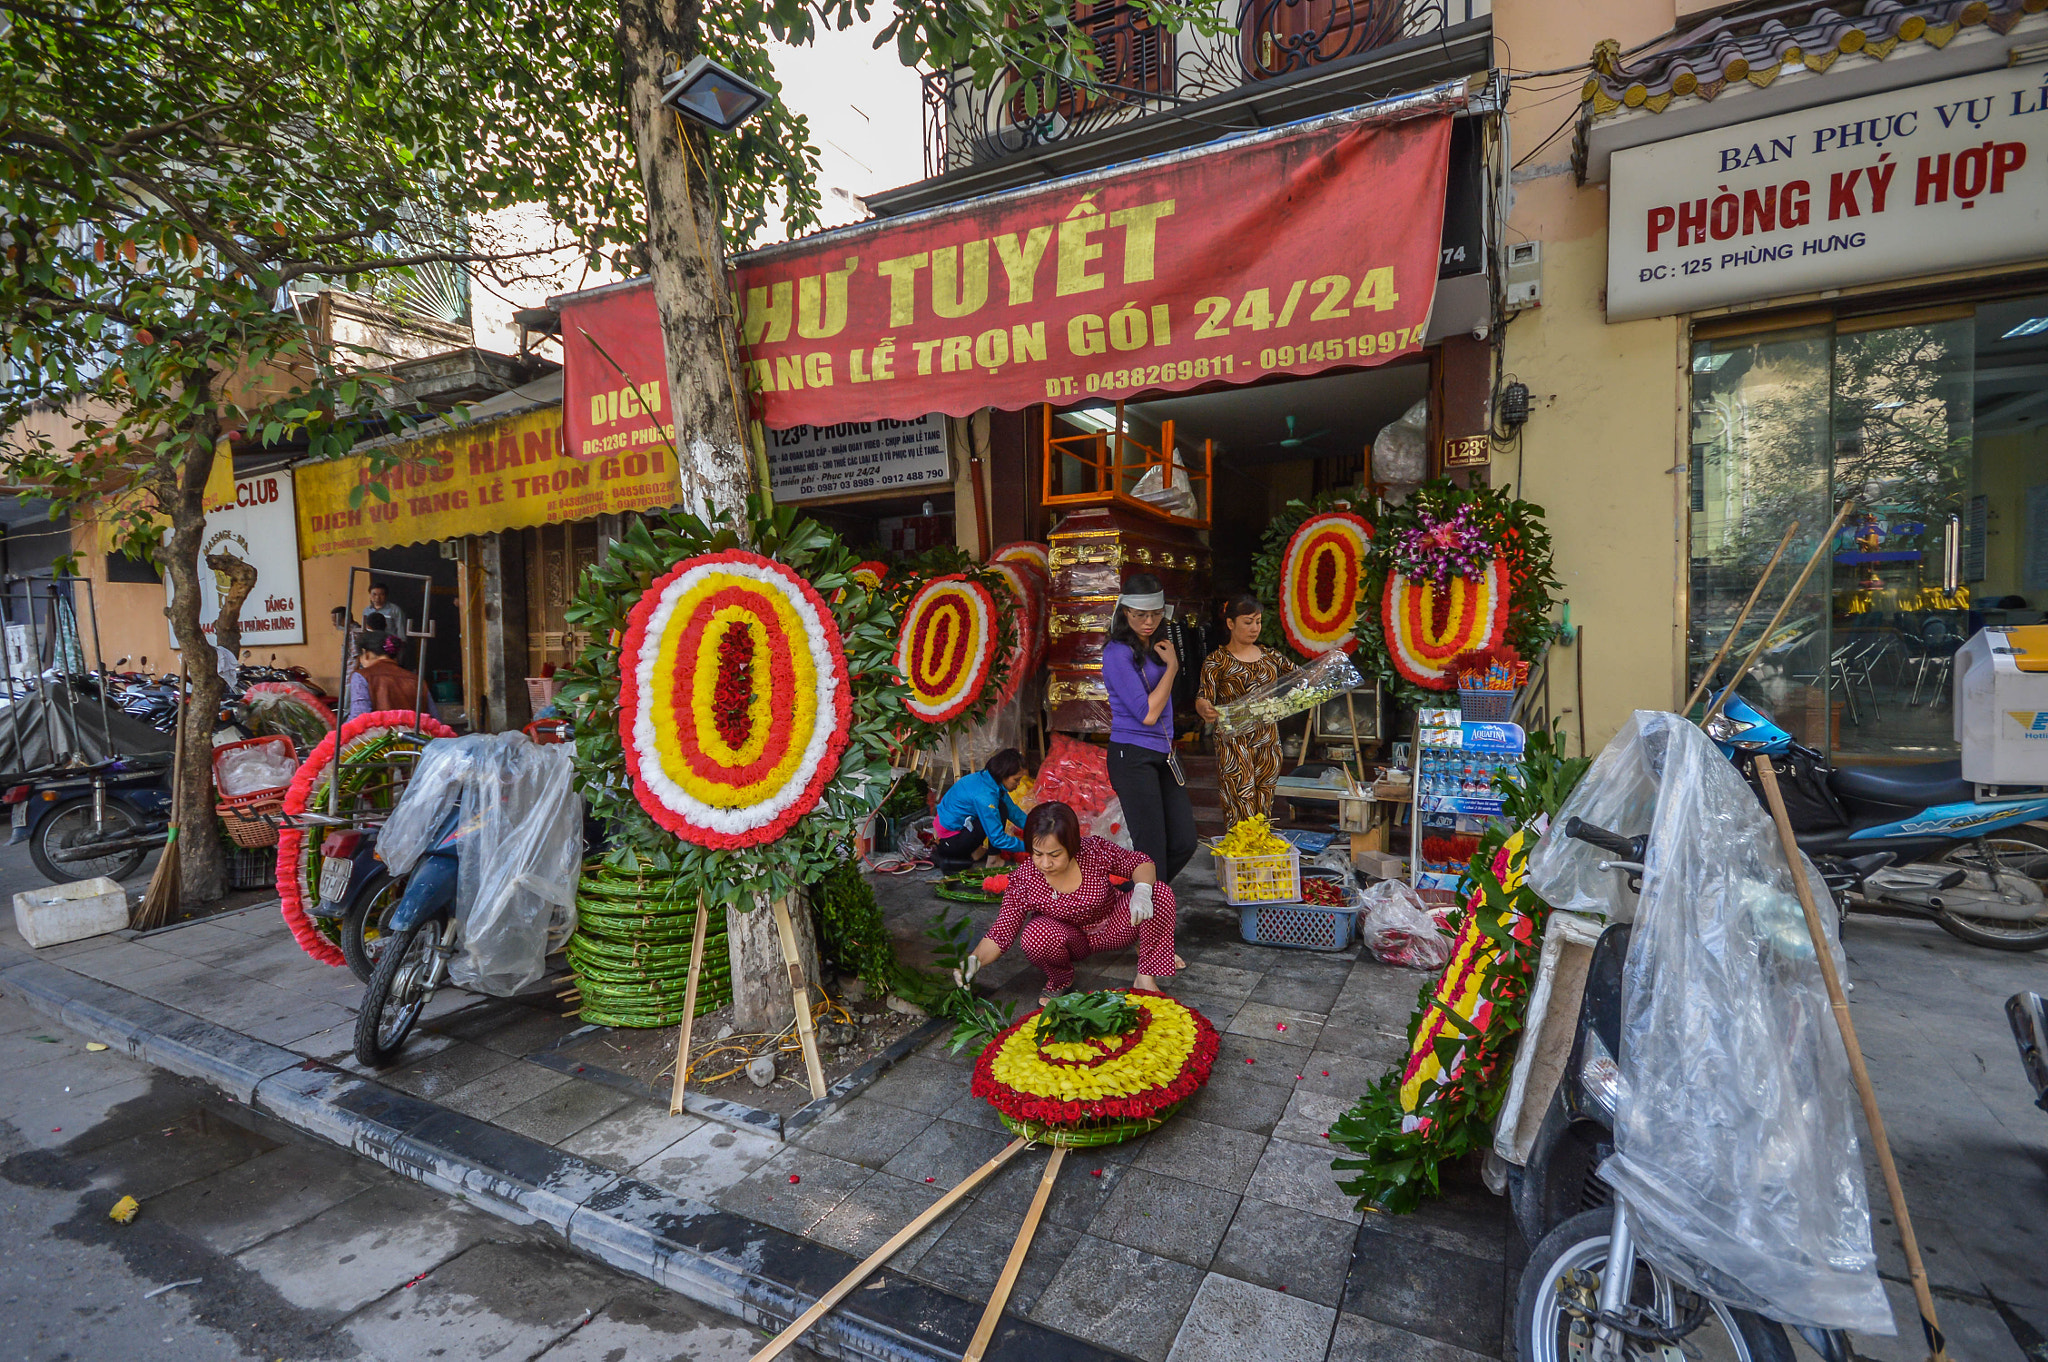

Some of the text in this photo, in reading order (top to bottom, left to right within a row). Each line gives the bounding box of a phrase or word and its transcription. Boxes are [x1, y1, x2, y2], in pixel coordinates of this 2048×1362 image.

[1718, 135, 1797, 173] BAN
[1811, 111, 1918, 154] PHỤC
[1933, 96, 1995, 129] VỤ
[1647, 140, 2027, 252] PHÒNG KÝ HỢP
[878, 187, 1176, 329] TUYẾT
[1440, 246, 1466, 265] 74
[1680, 257, 1713, 275] 125
[1720, 244, 1794, 270] PHÙNG
[1801, 231, 1867, 256] HƯNG
[591, 380, 662, 427] DỊCH
[849, 336, 897, 382] LỄ
[912, 321, 1048, 377] TRỌN
[1067, 301, 1172, 357] GÓI
[1194, 265, 1400, 341] 24/24
[1045, 376, 1079, 398] ĐT:
[1085, 354, 1234, 393] 0438269811
[1260, 322, 1425, 369] 0914519974
[924, 430, 940, 439] TANG
[817, 482, 838, 492] 0987
[840, 481, 851, 490] 03
[853, 478, 874, 488] 8989
[882, 473, 904, 484] 0912
[906, 471, 923, 481] 488
[926, 468, 944, 479] 790
[856, 466, 880, 477] 24/24
[236, 478, 279, 508] CLUB
[312, 508, 361, 534] DỊCH
[369, 501, 399, 523] VỤ
[407, 490, 469, 517] TANG
[478, 476, 504, 506] LỄ
[512, 463, 590, 498] TRỌN
[203, 530, 232, 557] MASSAGE
[288, 596, 294, 611] 6
[270, 615, 295, 631] HƯNG
